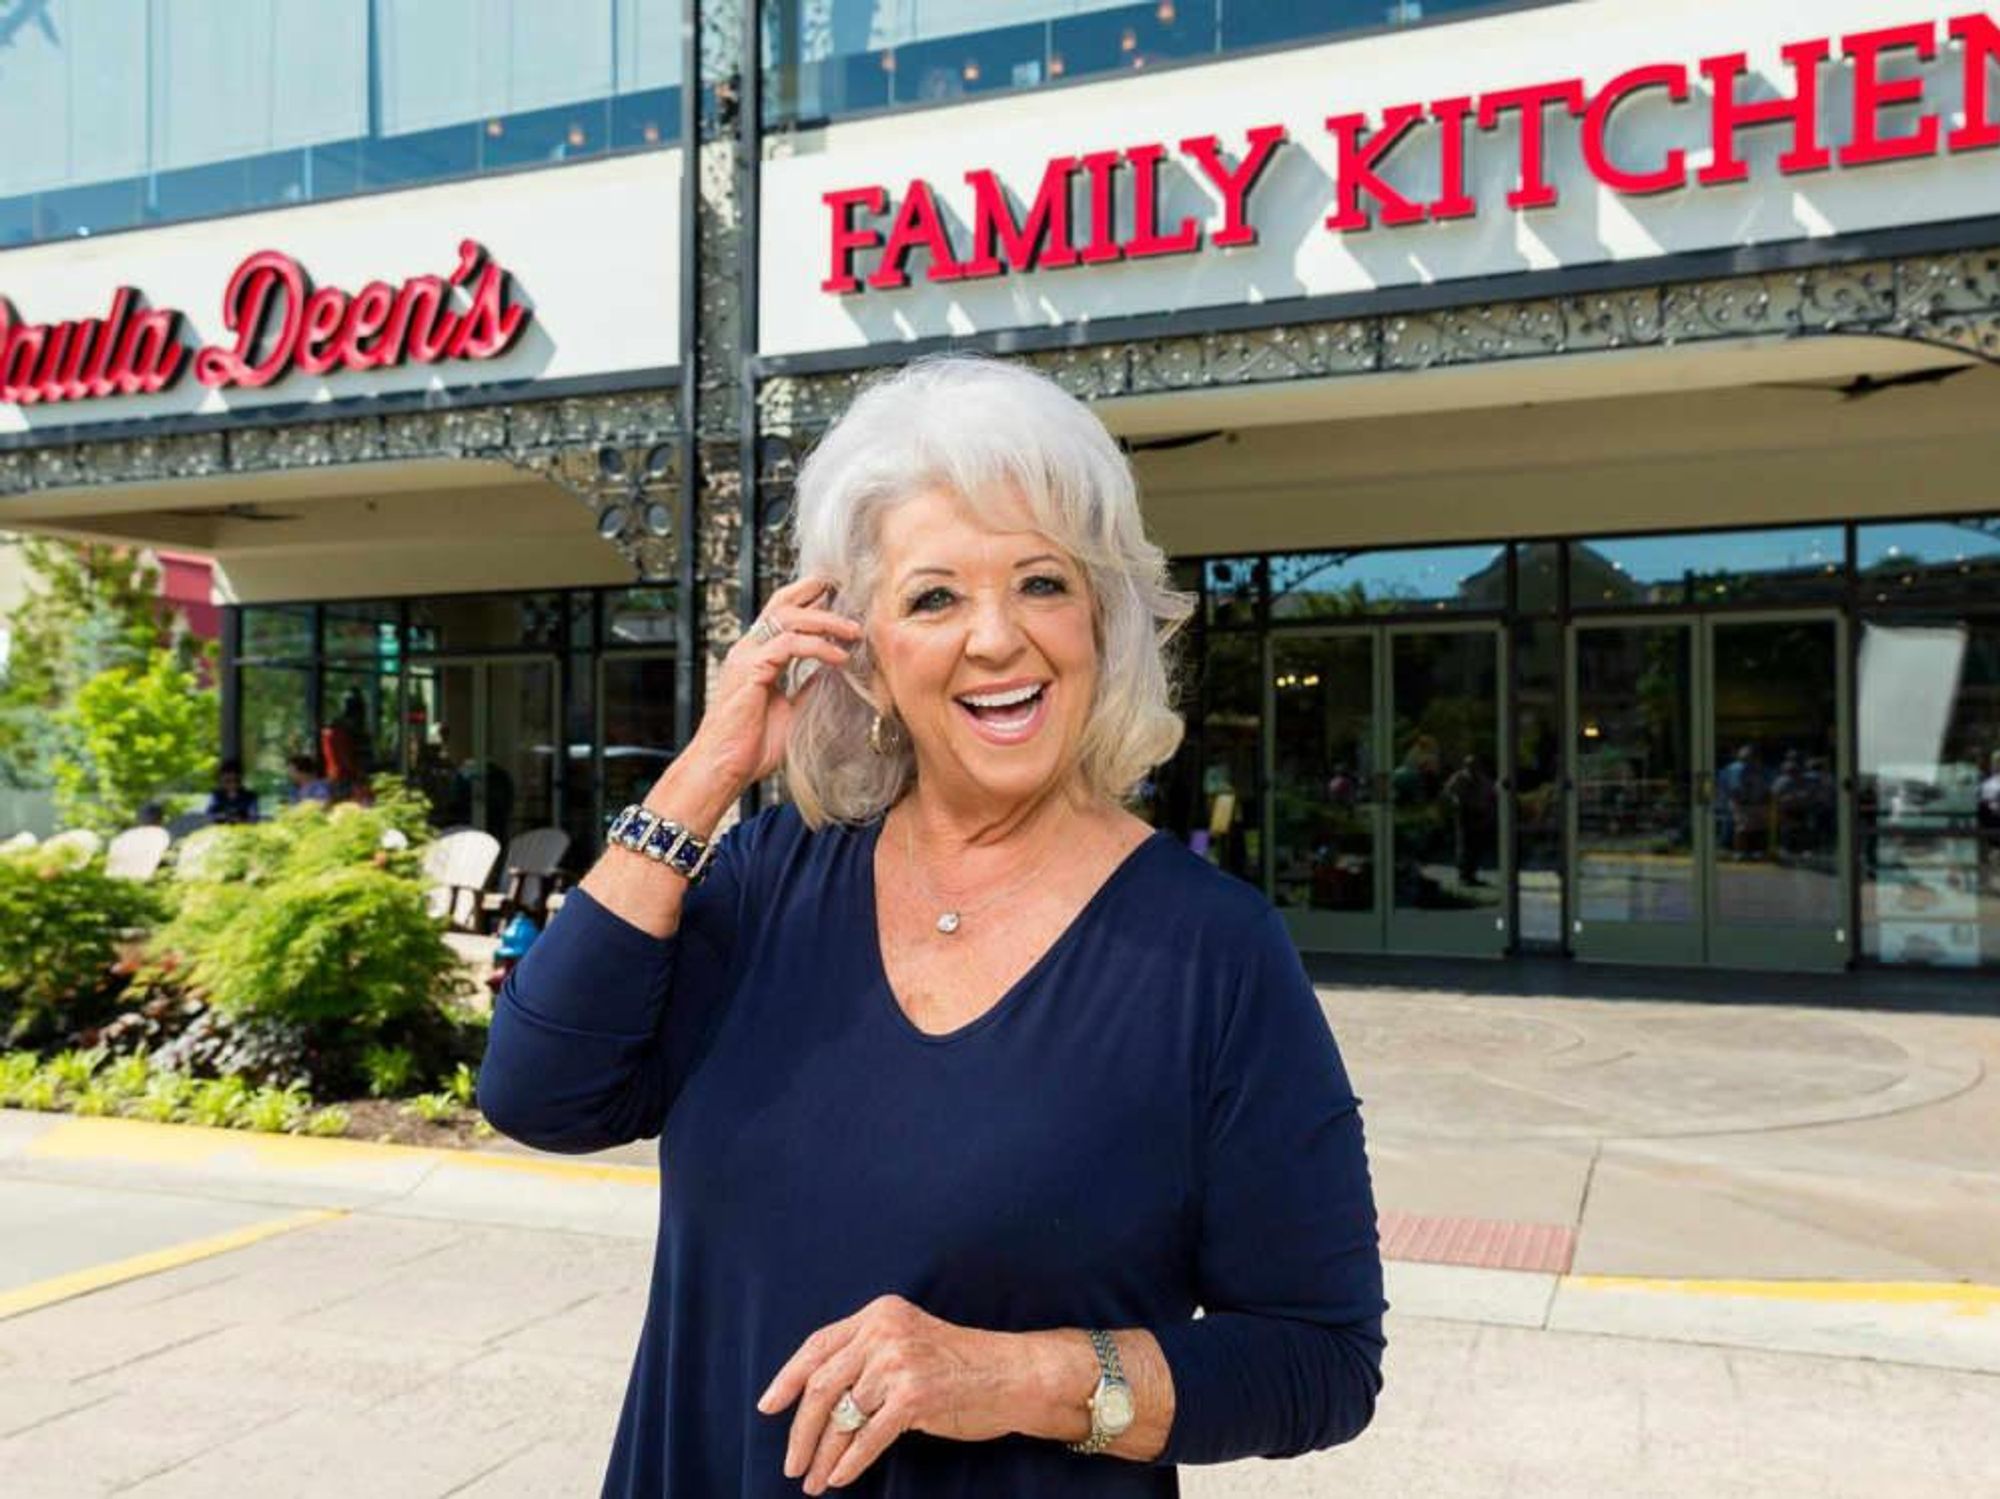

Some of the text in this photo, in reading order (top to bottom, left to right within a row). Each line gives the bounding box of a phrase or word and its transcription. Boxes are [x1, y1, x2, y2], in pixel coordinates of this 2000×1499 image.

[821, 123, 1286, 294] FAMILY
[0, 238, 524, 404] aula Deen's
